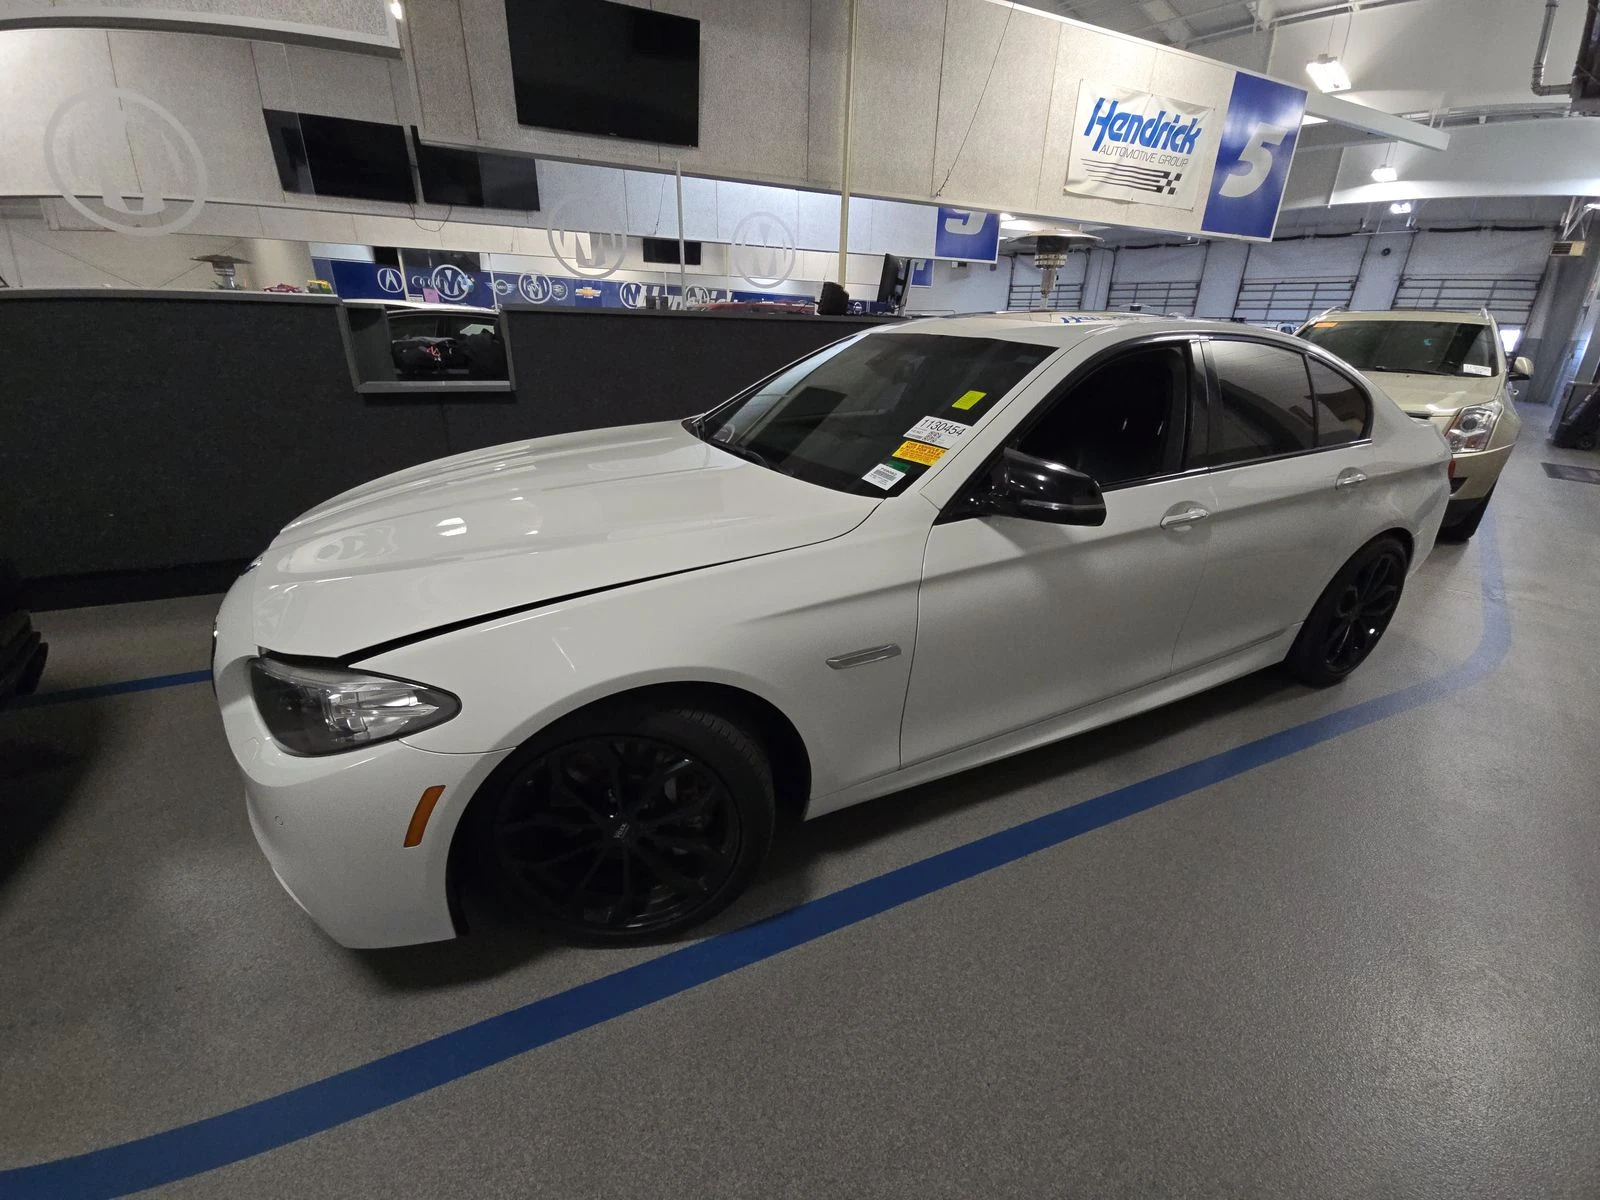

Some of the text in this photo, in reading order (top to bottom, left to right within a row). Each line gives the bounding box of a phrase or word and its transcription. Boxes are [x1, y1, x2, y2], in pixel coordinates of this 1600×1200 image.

[1084, 97, 1202, 154] Hendrick
[1099, 144, 1189, 167] AUTOMOTIVE GROUP
[1219, 123, 1289, 198] 5
[920, 419, 966, 436] 1130454
